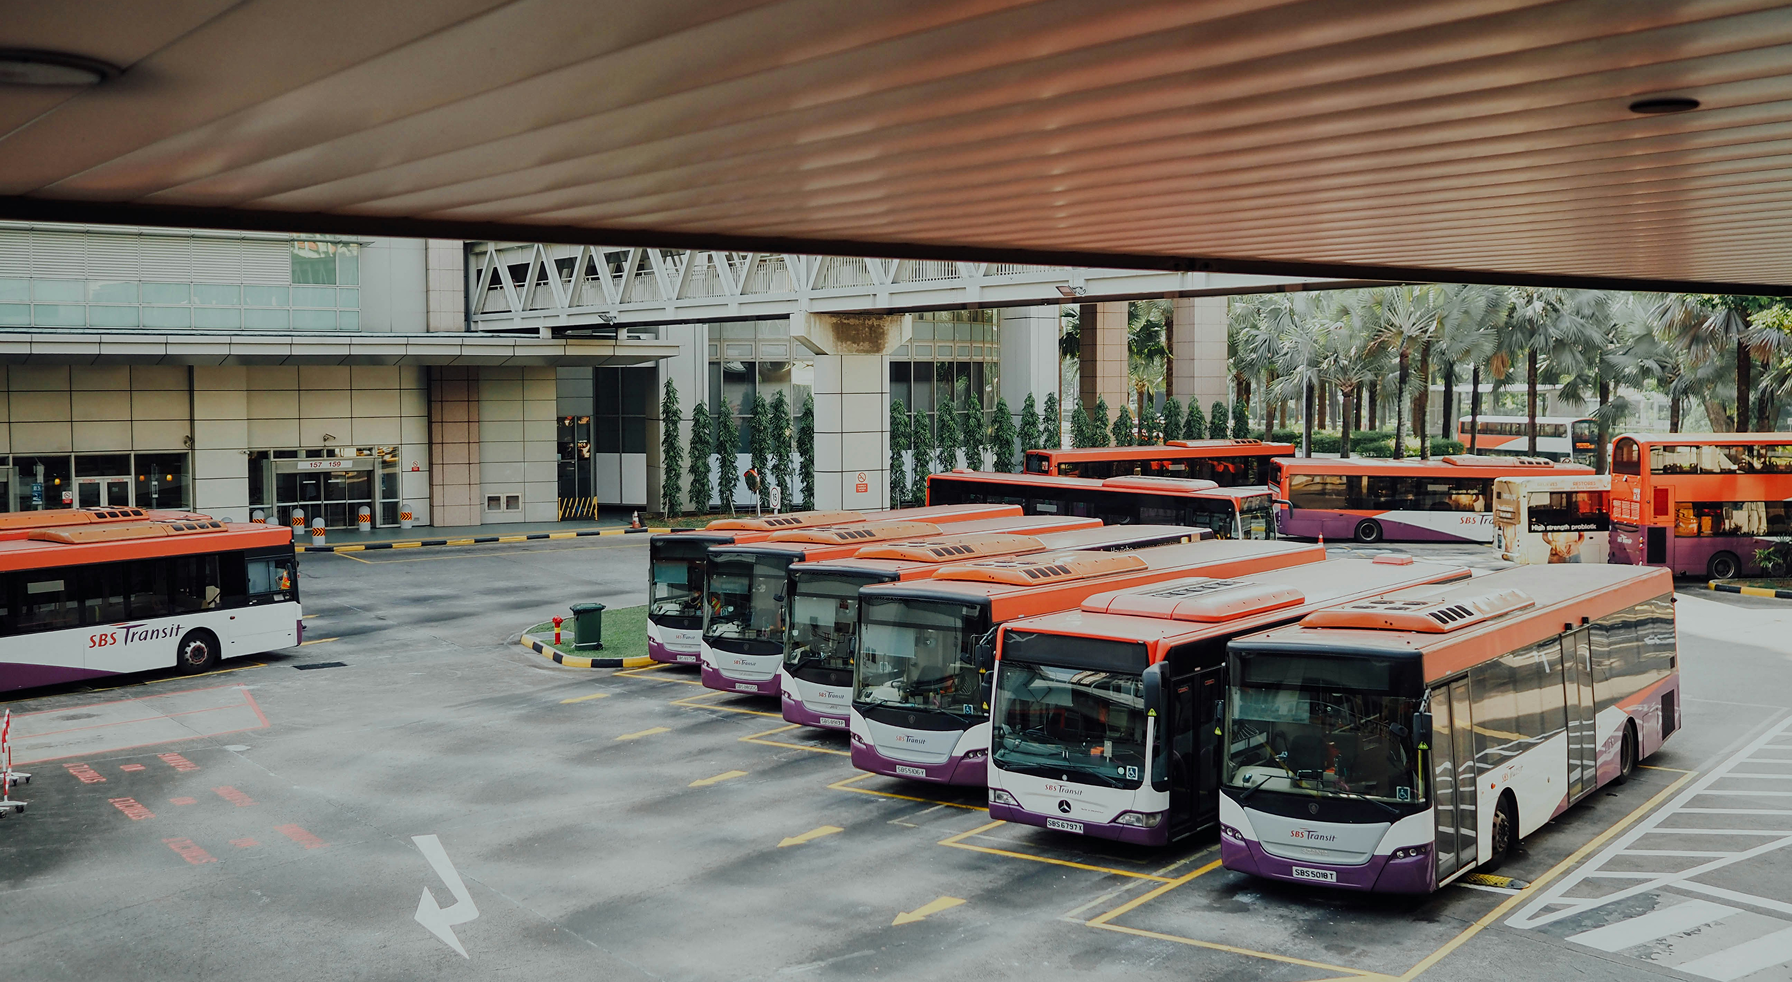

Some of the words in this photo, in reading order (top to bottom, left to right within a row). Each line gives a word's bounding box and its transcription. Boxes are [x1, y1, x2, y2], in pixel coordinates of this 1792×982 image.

[772, 493, 778, 502] 15
[1460, 516, 1476, 524] SBS
[88, 632, 116, 648] SBS
[116, 624, 184, 645] Transit
[740, 658, 756, 666] Transit
[825, 691, 845, 699] Transit
[904, 734, 926, 745] Transit
[1045, 784, 1057, 792] SBS
[1056, 784, 1083, 796] Transit
[1290, 830, 1304, 838] SBS
[1304, 830, 1337, 842] Transit
